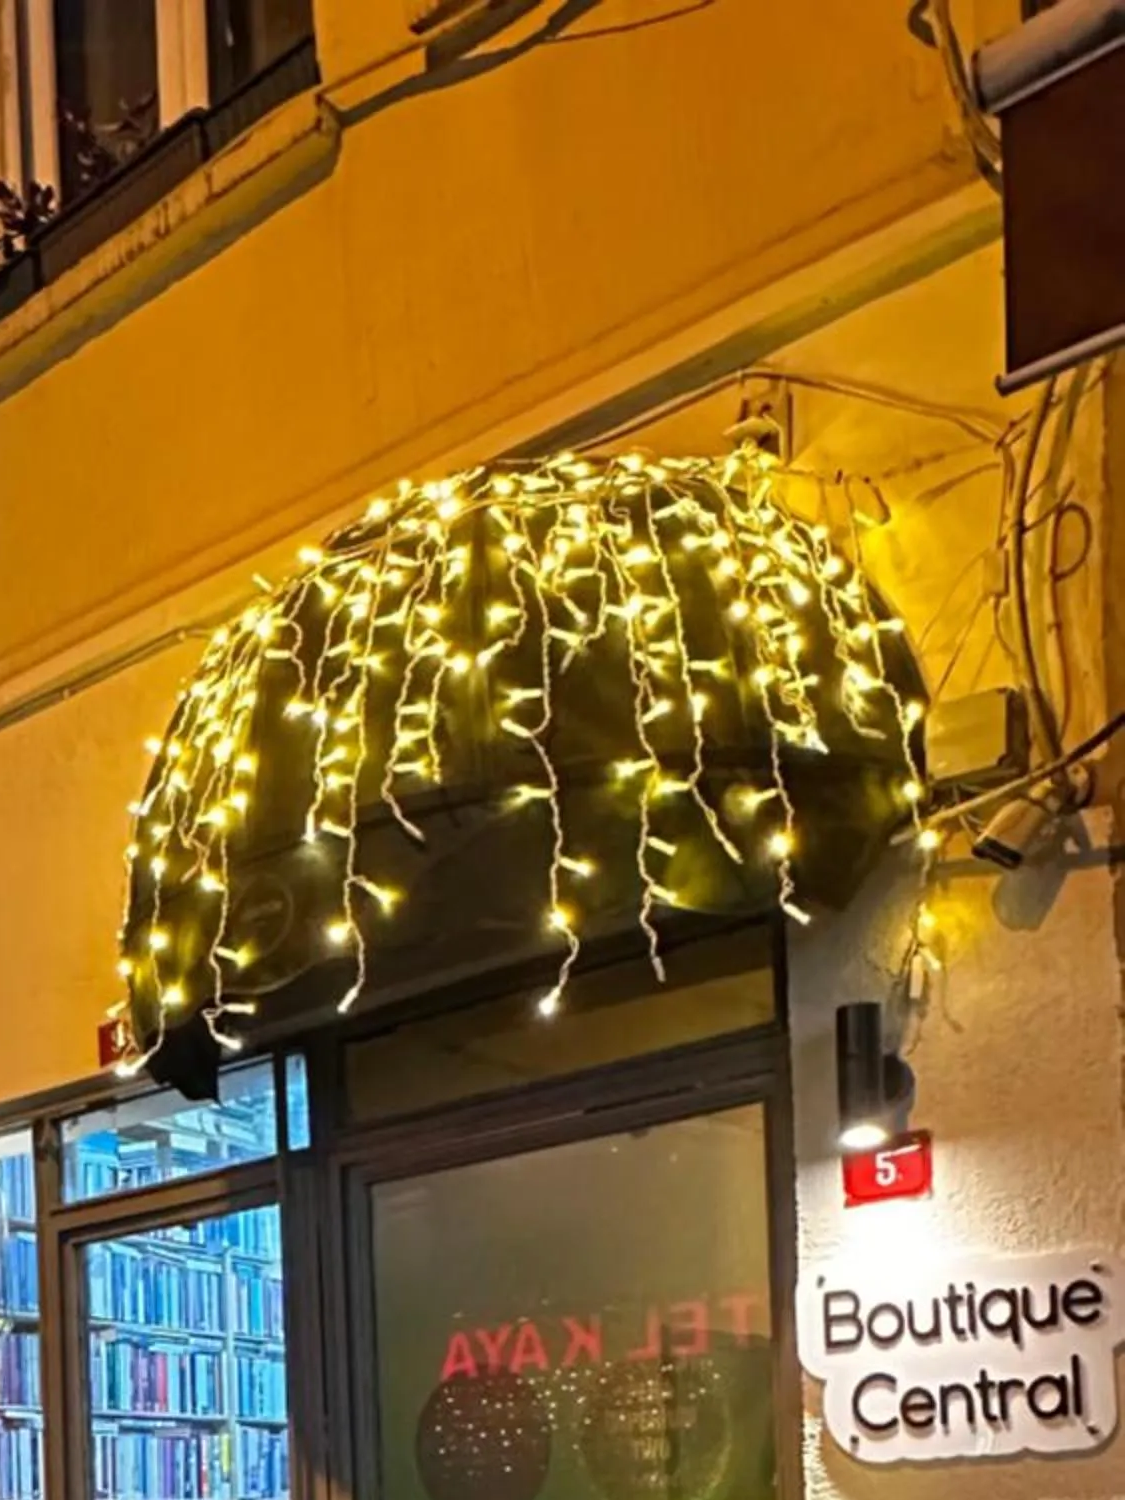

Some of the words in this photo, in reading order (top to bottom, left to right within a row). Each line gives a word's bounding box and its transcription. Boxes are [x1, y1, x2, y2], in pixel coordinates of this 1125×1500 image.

[874, 1151, 897, 1187] 5
[823, 1279, 1103, 1354] Boutique
[851, 1354, 1085, 1432] Central
